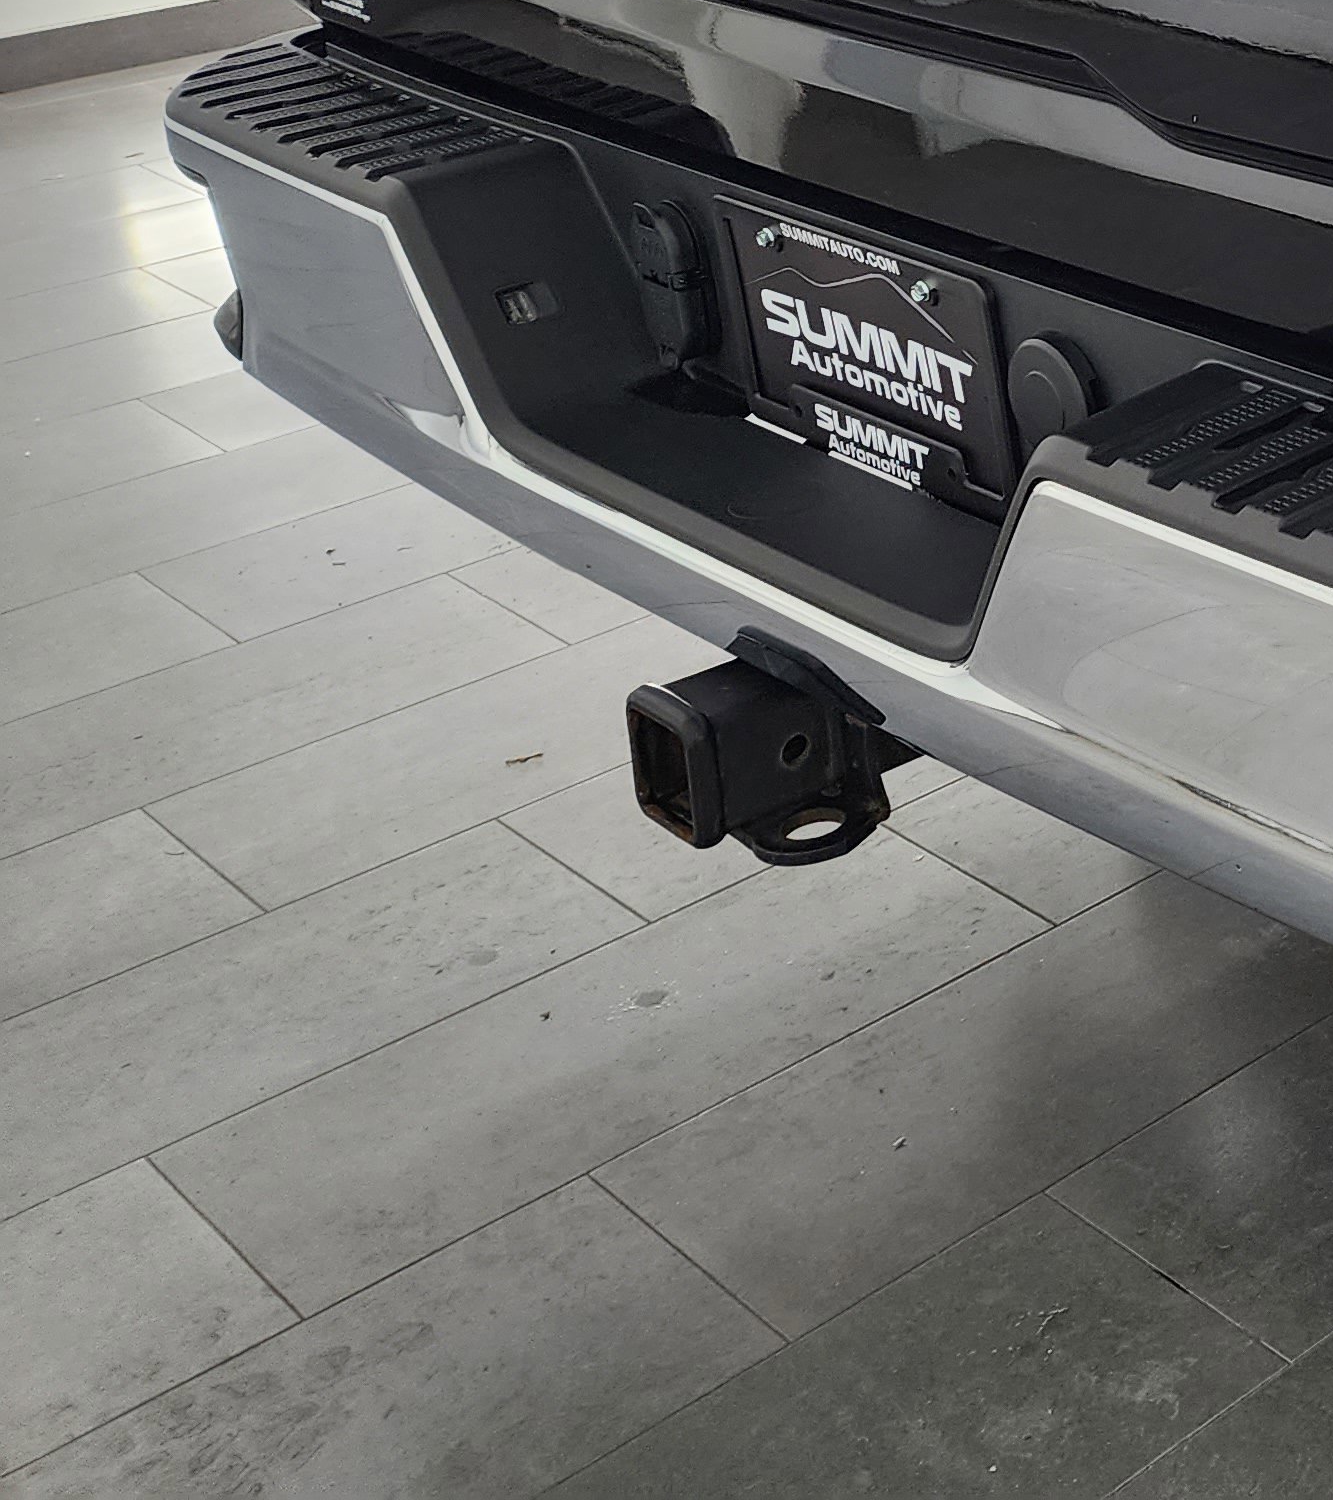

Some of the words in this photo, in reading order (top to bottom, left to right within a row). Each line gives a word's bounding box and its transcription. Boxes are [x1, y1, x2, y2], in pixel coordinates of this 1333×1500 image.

[779, 222, 901, 276] SUMMITAUTO.COM
[760, 288, 973, 404] SUMMIT
[790, 339, 963, 432] Automotive
[814, 402, 930, 470] SUMMIT
[828, 434, 922, 487] Automotive
